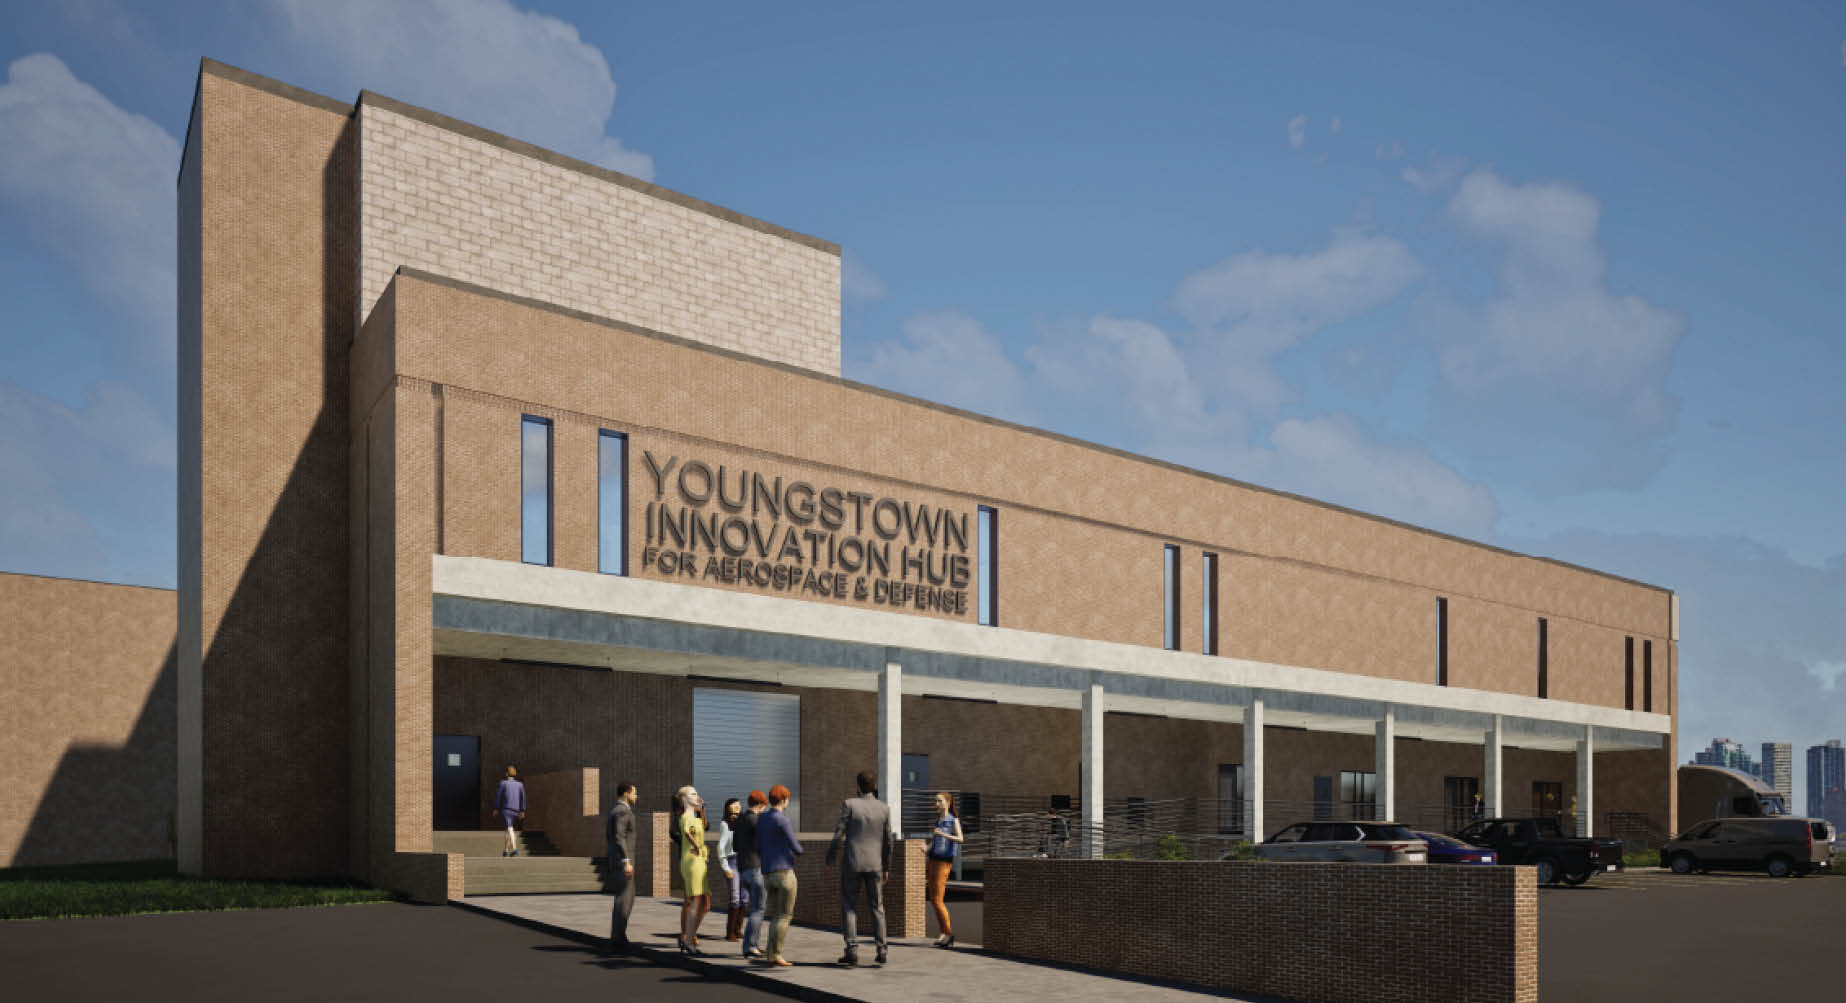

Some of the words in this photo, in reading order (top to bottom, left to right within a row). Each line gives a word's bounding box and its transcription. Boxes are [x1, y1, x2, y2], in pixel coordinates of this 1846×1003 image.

[644, 450, 968, 551] YOUNGSTOWN
[643, 546, 697, 577] FOR
[703, 555, 849, 599] AEROSPACE
[854, 577, 868, 600] &
[874, 580, 968, 615] DEFENSE
[646, 501, 890, 576] INNOVATION
[901, 545, 971, 588] HUB
